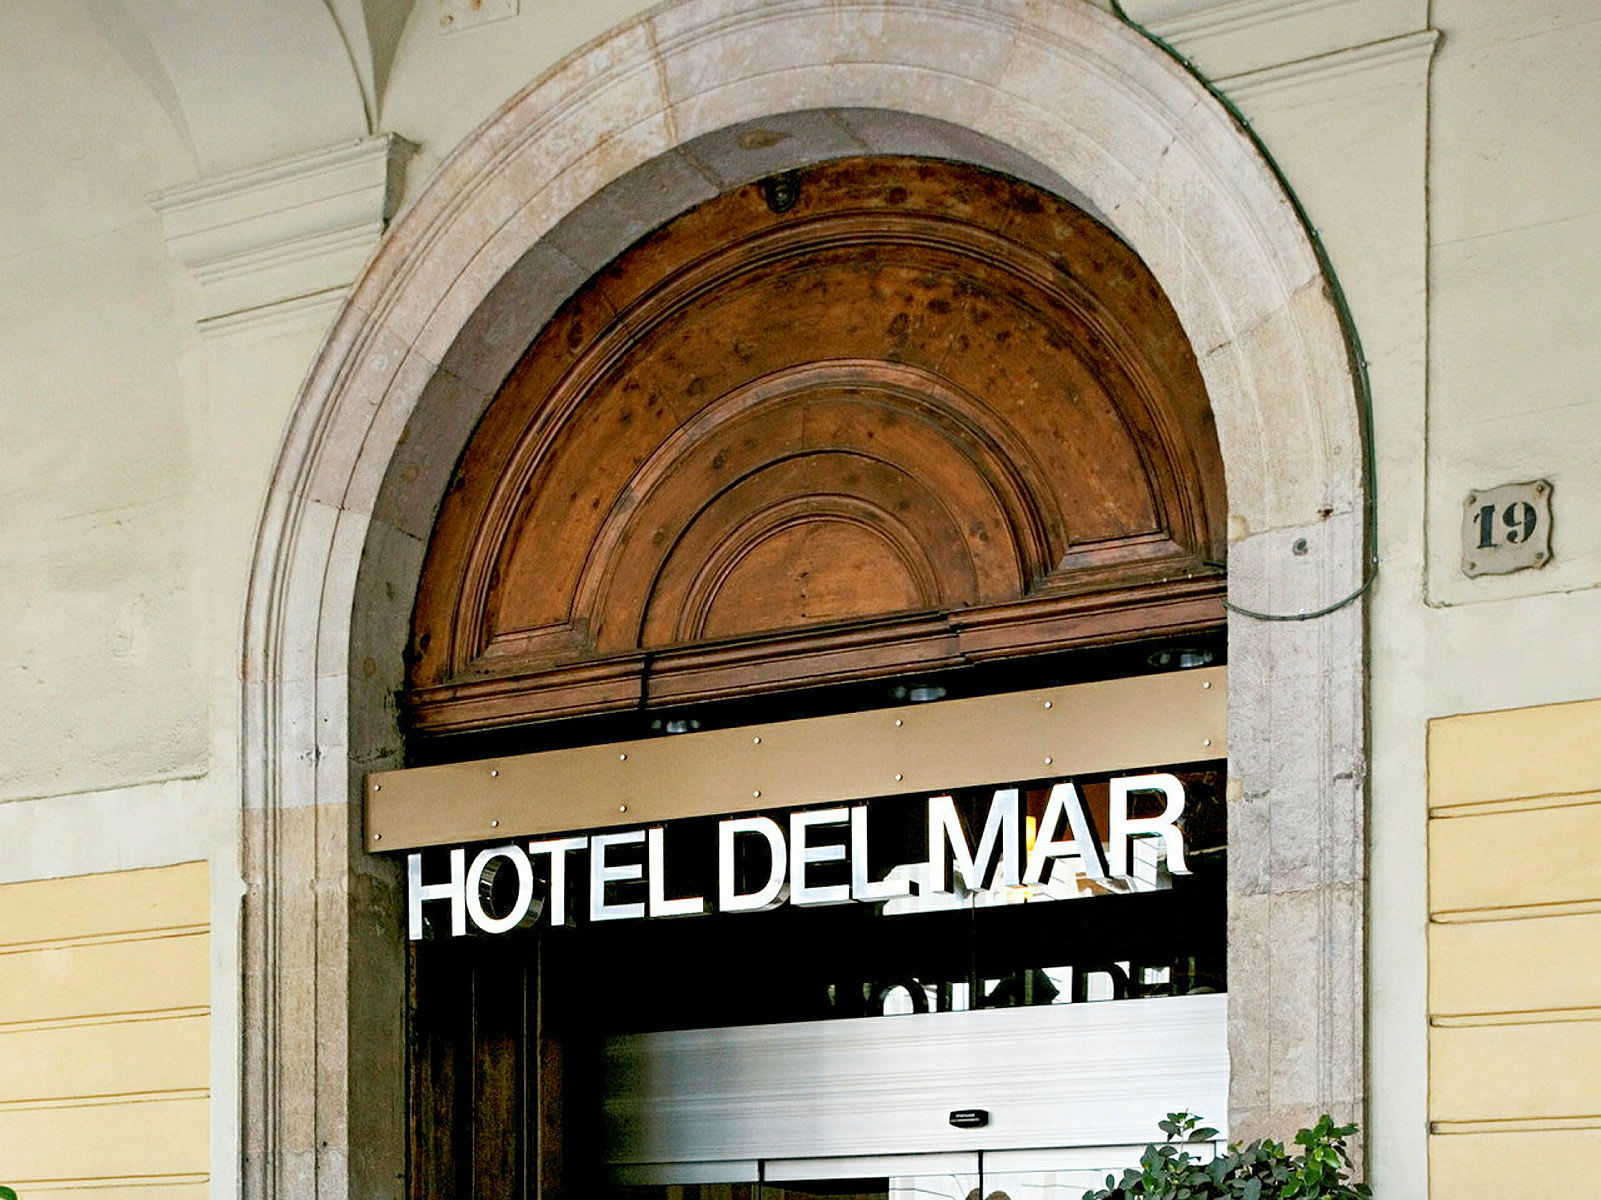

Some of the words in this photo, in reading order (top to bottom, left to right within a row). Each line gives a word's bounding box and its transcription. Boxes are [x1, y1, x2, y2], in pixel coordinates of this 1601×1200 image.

[1473, 501, 1537, 549] 19
[408, 827, 704, 940] HOTEL
[719, 805, 912, 912] DEL
[929, 773, 1193, 893] MAR
